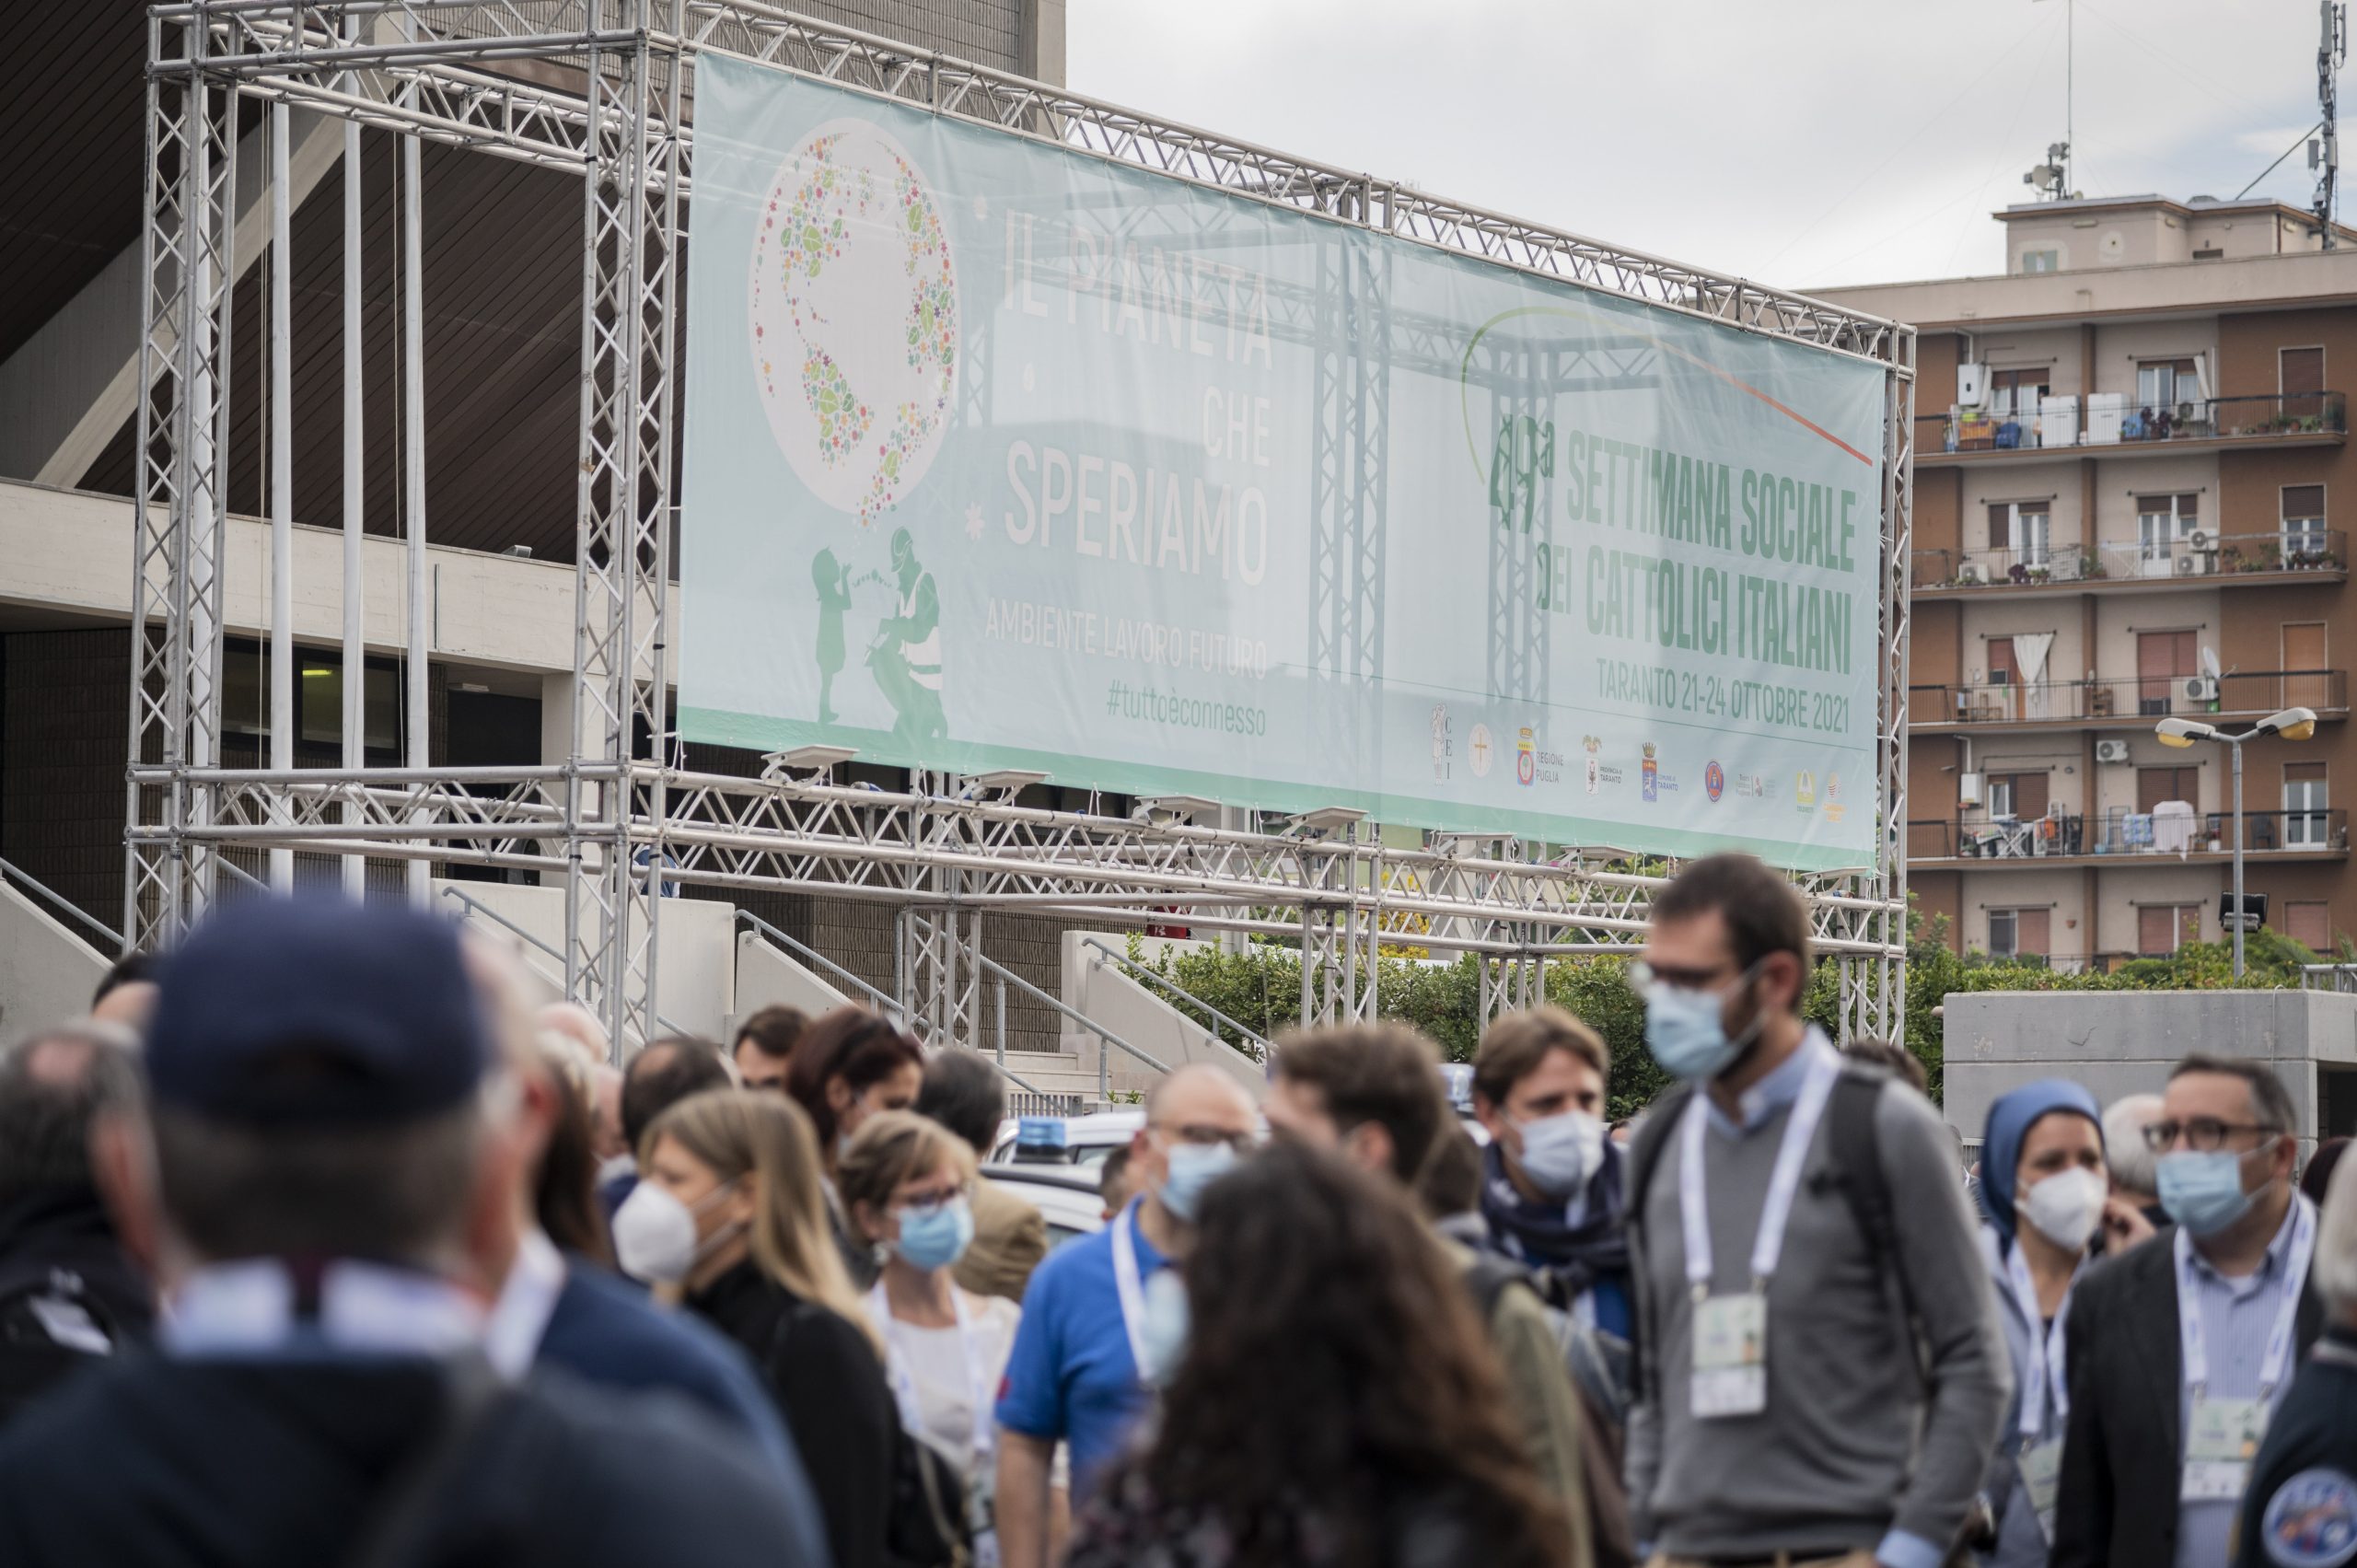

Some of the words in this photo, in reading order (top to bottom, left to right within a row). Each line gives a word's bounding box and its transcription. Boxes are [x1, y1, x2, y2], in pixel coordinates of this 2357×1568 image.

[1004, 208, 1049, 318] IL
[1067, 226, 1272, 369] PIANETA
[1202, 385, 1271, 468] CHE
[1004, 439, 1268, 587] SPERIAMO
[1567, 429, 1732, 552] SETTIMANA
[1740, 468, 1857, 573] SOCIALE
[984, 598, 1098, 656] AMBIENTE
[1103, 616, 1183, 668] LAVORO
[1188, 630, 1268, 681] FUTURO
[1537, 541, 1573, 615] DEI
[1585, 544, 1729, 656] CATTOLICI
[1736, 573, 1852, 676] ITALIANI
[1107, 678, 1267, 738] #tuttoèconnesso
[1596, 657, 1678, 710] TARANTO
[1681, 670, 1727, 716] 21-24
[1731, 679, 1809, 729] OTTOBRE
[1813, 691, 1851, 734] 2021
[1536, 750, 1564, 766] REGIONE
[1536, 769, 1560, 784] PUGLIA
[1600, 774, 1621, 784] TARANTO
[1657, 781, 1678, 792] TARANTO
